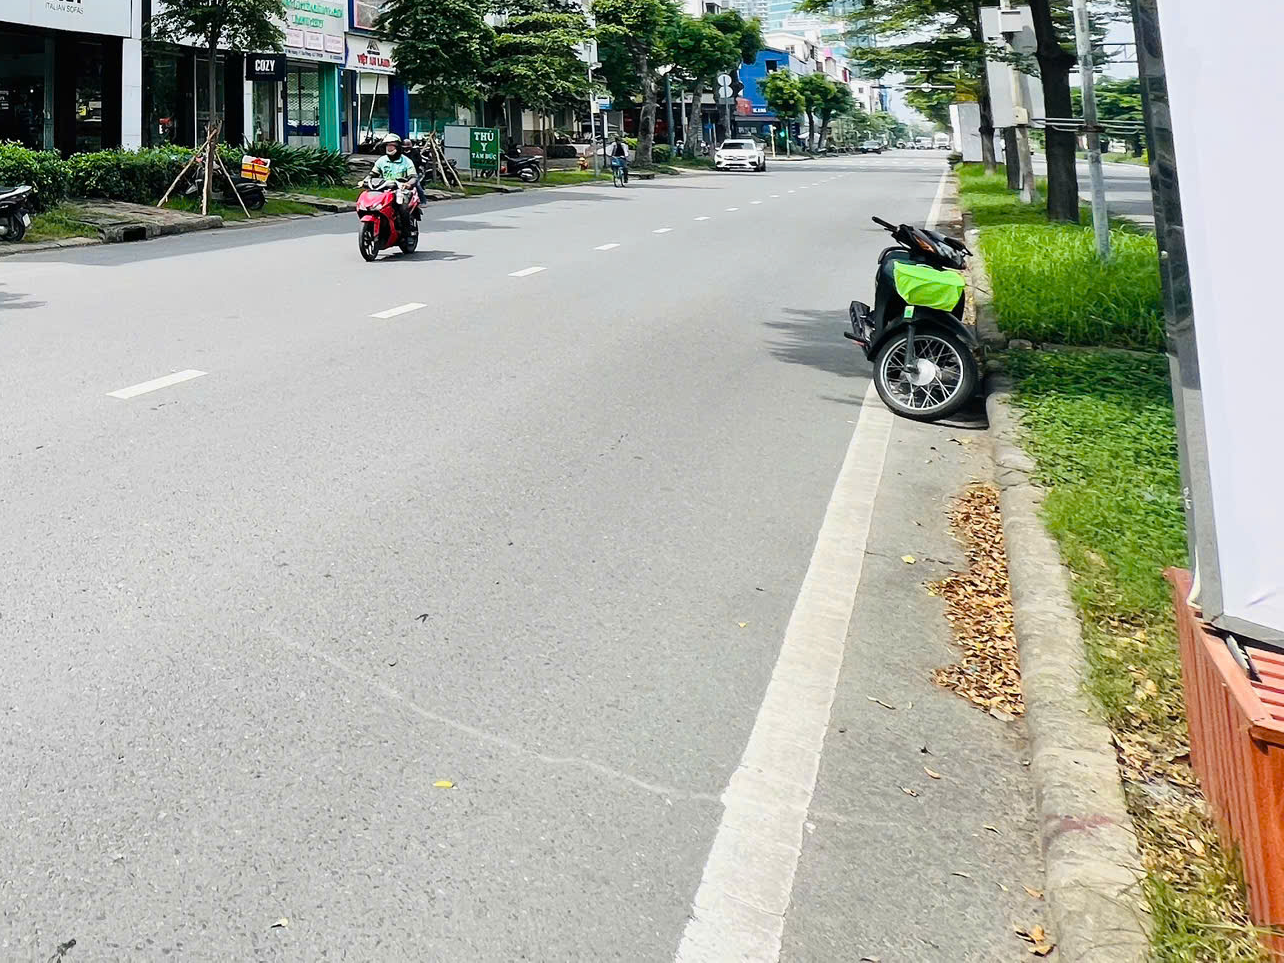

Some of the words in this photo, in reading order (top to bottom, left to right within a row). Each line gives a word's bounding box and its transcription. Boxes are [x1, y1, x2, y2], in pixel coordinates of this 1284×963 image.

[66, 5, 84, 15] SOFAS
[255, 59, 276, 72] COZY
[473, 130, 494, 141] THÚ
[480, 142, 488, 151] Y
